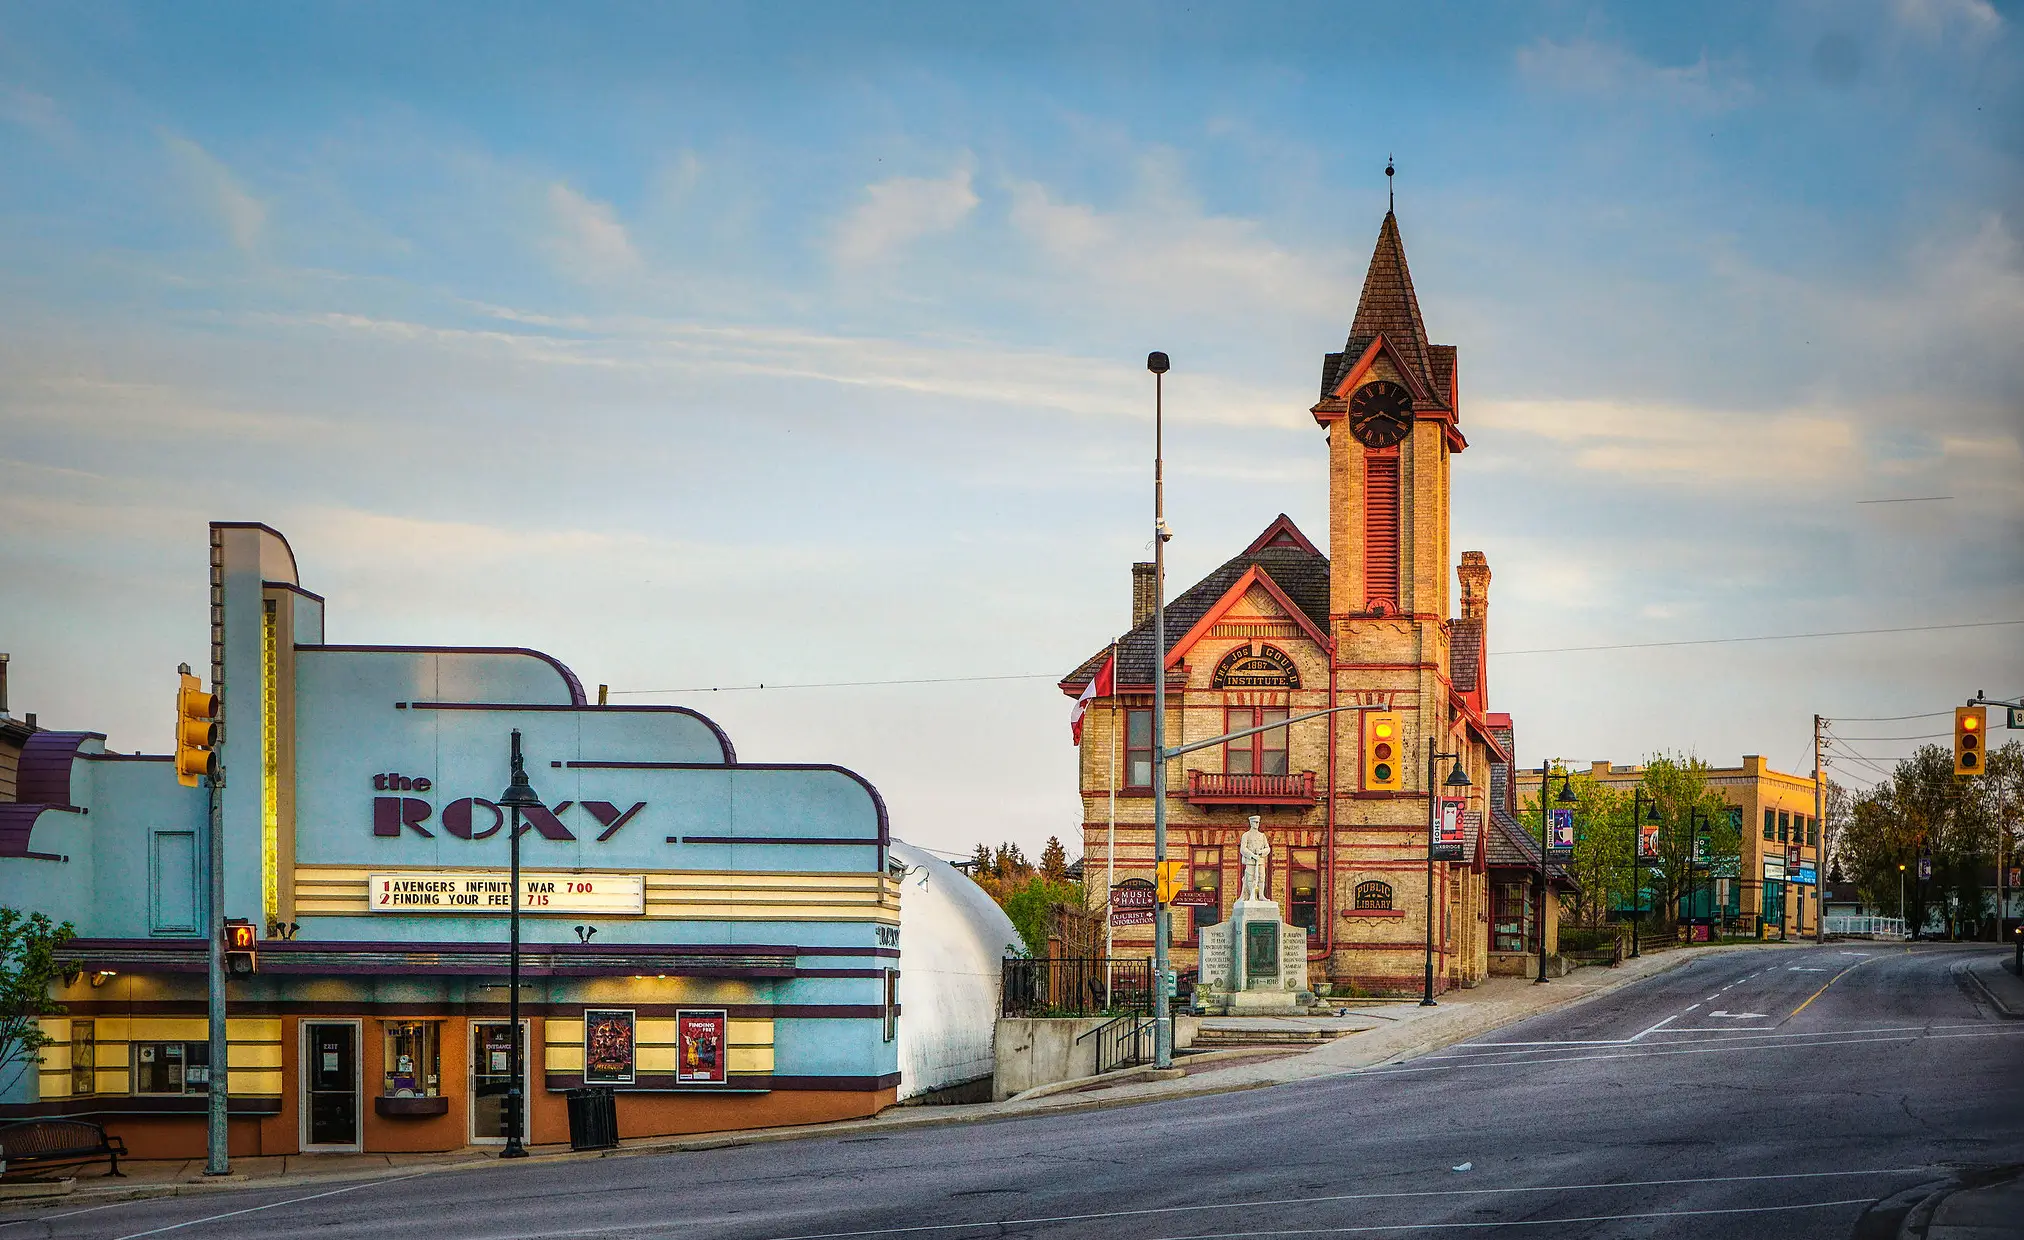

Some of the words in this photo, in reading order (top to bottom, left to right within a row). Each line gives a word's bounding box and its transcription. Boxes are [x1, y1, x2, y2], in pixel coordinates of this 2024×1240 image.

[1214, 663, 1229, 683] THE
[1231, 648, 1249, 661] JOS
[1265, 647, 1298, 683] GOULD
[1247, 661, 1268, 670] 1887
[372, 772, 432, 791] the
[372, 796, 647, 841] ROXY
[382, 880, 390, 892] 1
[393, 881, 456, 892] AVENGERS
[527, 882, 555, 893] WAR
[566, 882, 593, 893] 700
[1357, 882, 1391, 899] PUBLIC
[379, 892, 390, 905] 2
[393, 893, 440, 905] FINDING
[448, 894, 479, 905] YOUR
[1356, 900, 1391, 909] LIBRARY
[1111, 917, 1154, 927] INFORMATION
[1112, 913, 1144, 921] TOURIST
